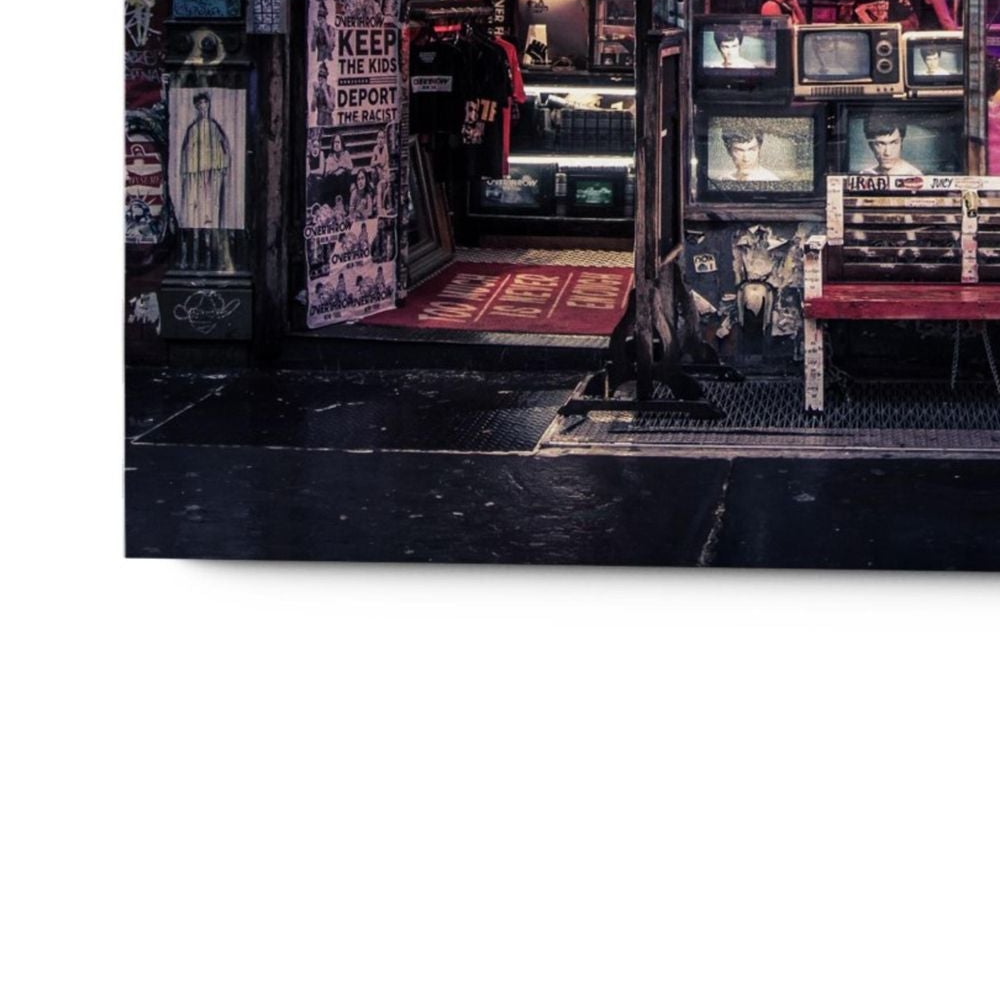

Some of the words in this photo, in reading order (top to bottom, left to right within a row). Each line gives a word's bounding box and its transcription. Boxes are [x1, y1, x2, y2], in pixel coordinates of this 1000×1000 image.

[339, 28, 397, 57] KEEP
[339, 58, 365, 75] THE
[368, 57, 398, 74] KIDS
[338, 87, 398, 108] DEPORT
[338, 111, 360, 124] THE
[362, 108, 398, 122] RACIST
[930, 178, 953, 189] JUICY
